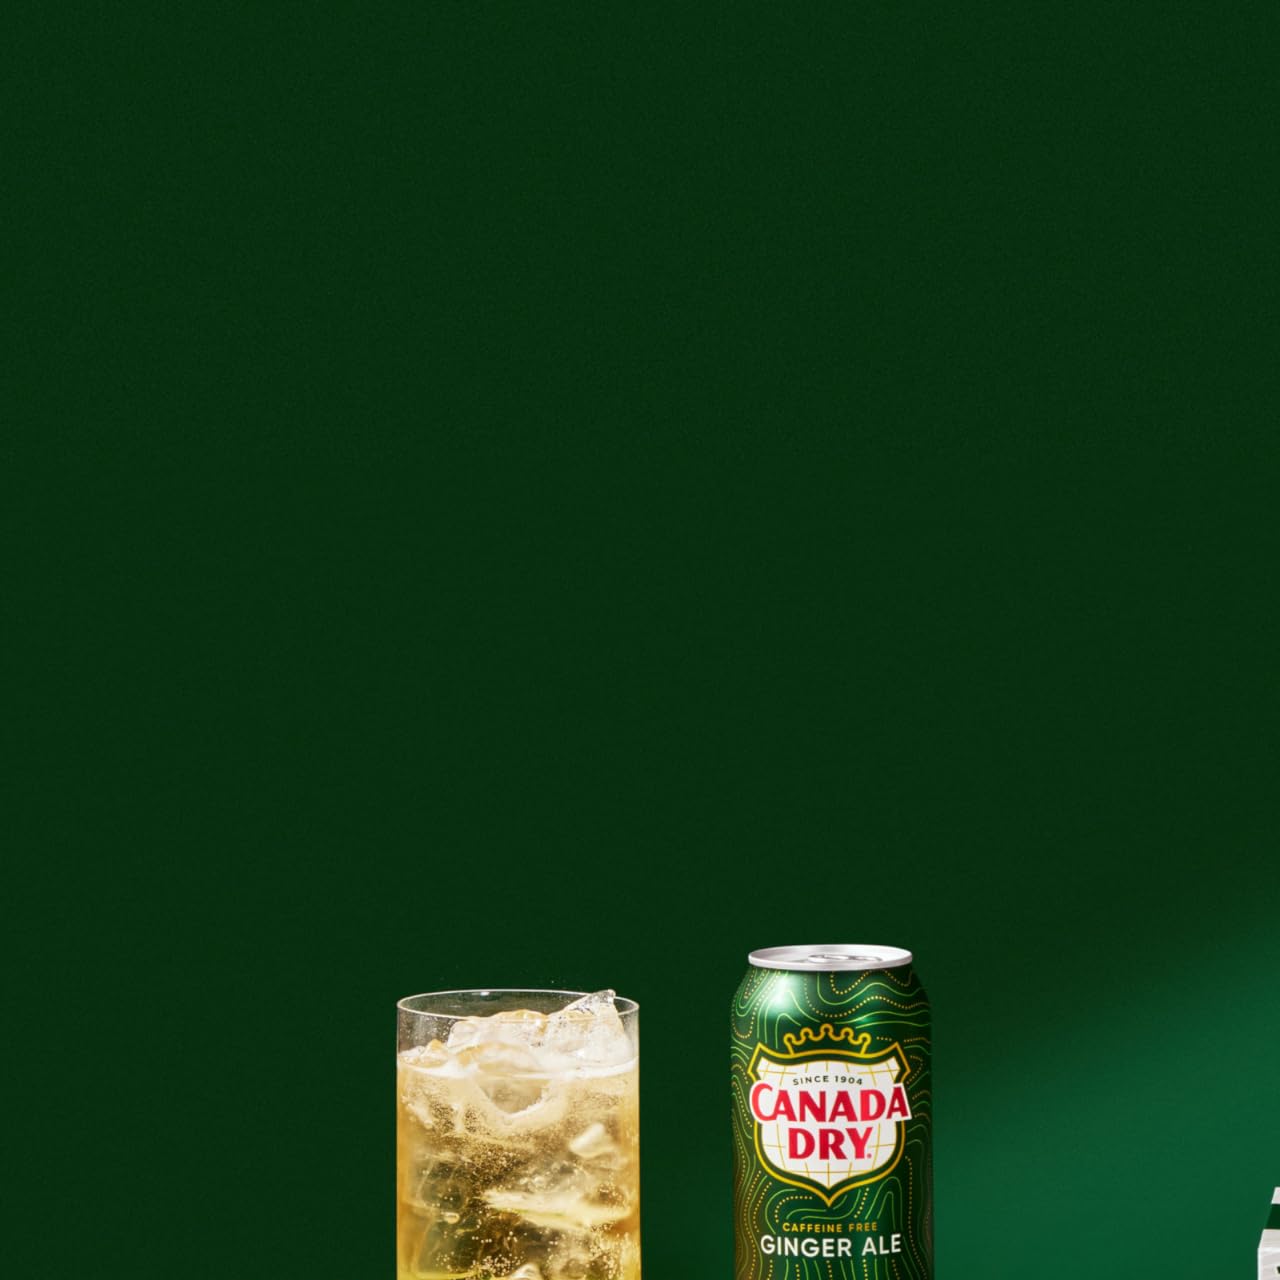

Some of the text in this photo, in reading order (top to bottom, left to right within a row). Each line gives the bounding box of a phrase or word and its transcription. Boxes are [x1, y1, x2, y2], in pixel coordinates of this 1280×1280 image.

[792, 1075, 864, 1086] SINCE 1904
[751, 1083, 909, 1123] CANADA
[788, 1126, 873, 1160] DRY
[782, 1222, 878, 1233] CAFFEINE FREE
[760, 1233, 902, 1258] GINGER ALE
